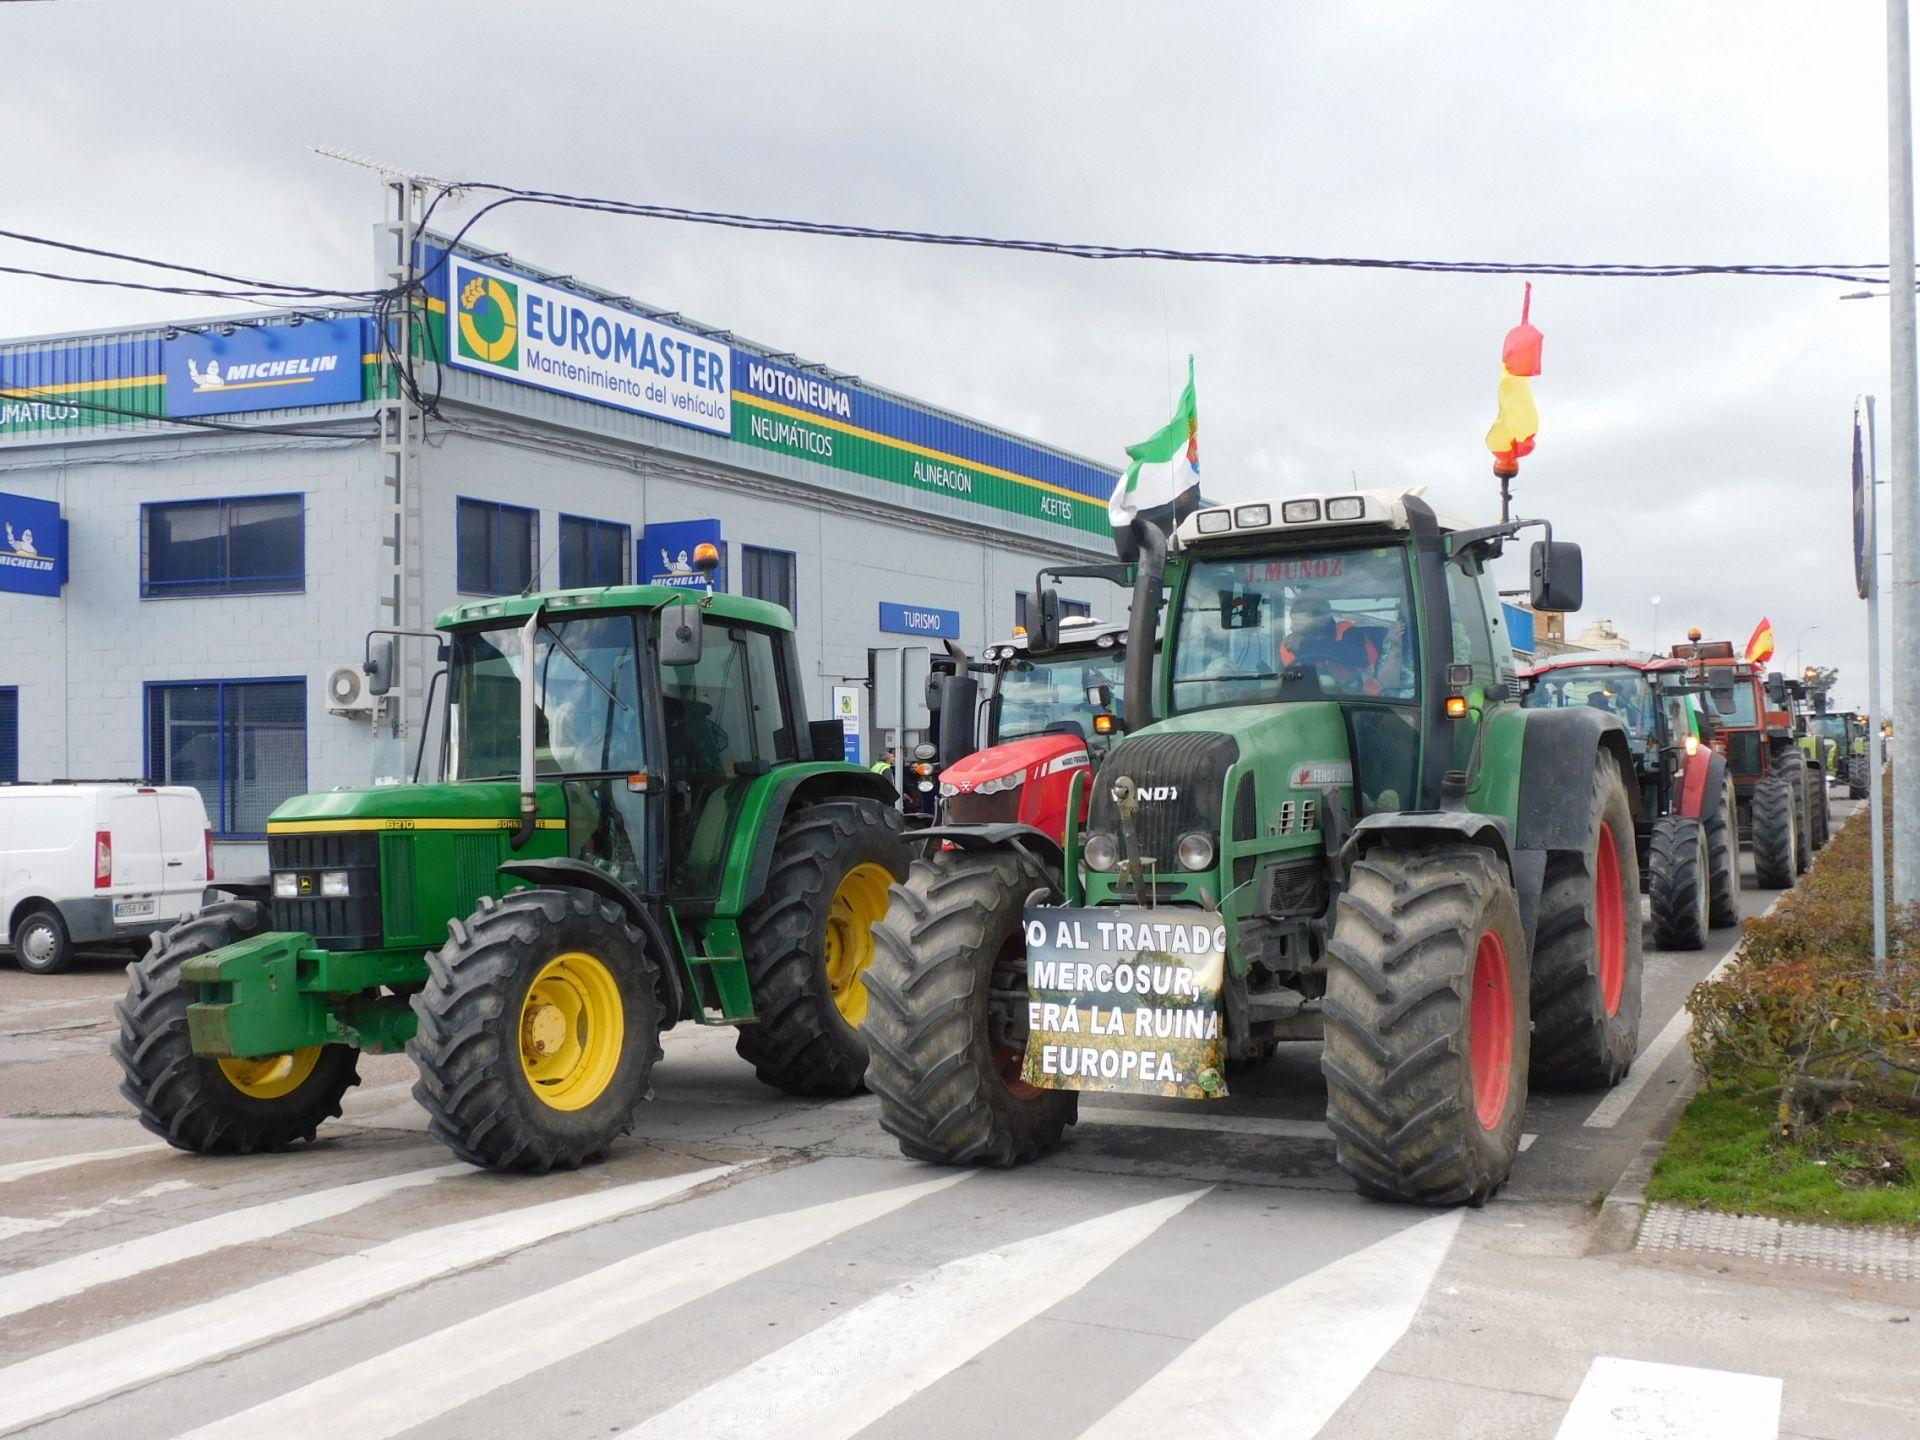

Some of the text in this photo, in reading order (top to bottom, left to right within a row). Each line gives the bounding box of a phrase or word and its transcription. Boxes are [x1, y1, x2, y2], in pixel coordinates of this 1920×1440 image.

[526, 294, 725, 394] EUROMASTER
[226, 354, 338, 381] MICHELIN
[526, 348, 725, 420] Mantenimiento del vehículo
[748, 362, 851, 418] MOTONEUMA
[751, 413, 833, 457] NEUMÁTICOS
[912, 461, 972, 494] ALINEACIÓN
[903, 611, 941, 630] TURISMO
[386, 820, 415, 830] 6210
[1055, 921, 1090, 950] AL
[1097, 922, 1226, 954] TRATADO
[1033, 960, 1201, 1003] MERCOSUR,
[1089, 1006, 1126, 1037] LA
[1135, 1008, 1218, 1040] RUINA
[1042, 1045, 1183, 1082] EUROPEA.
